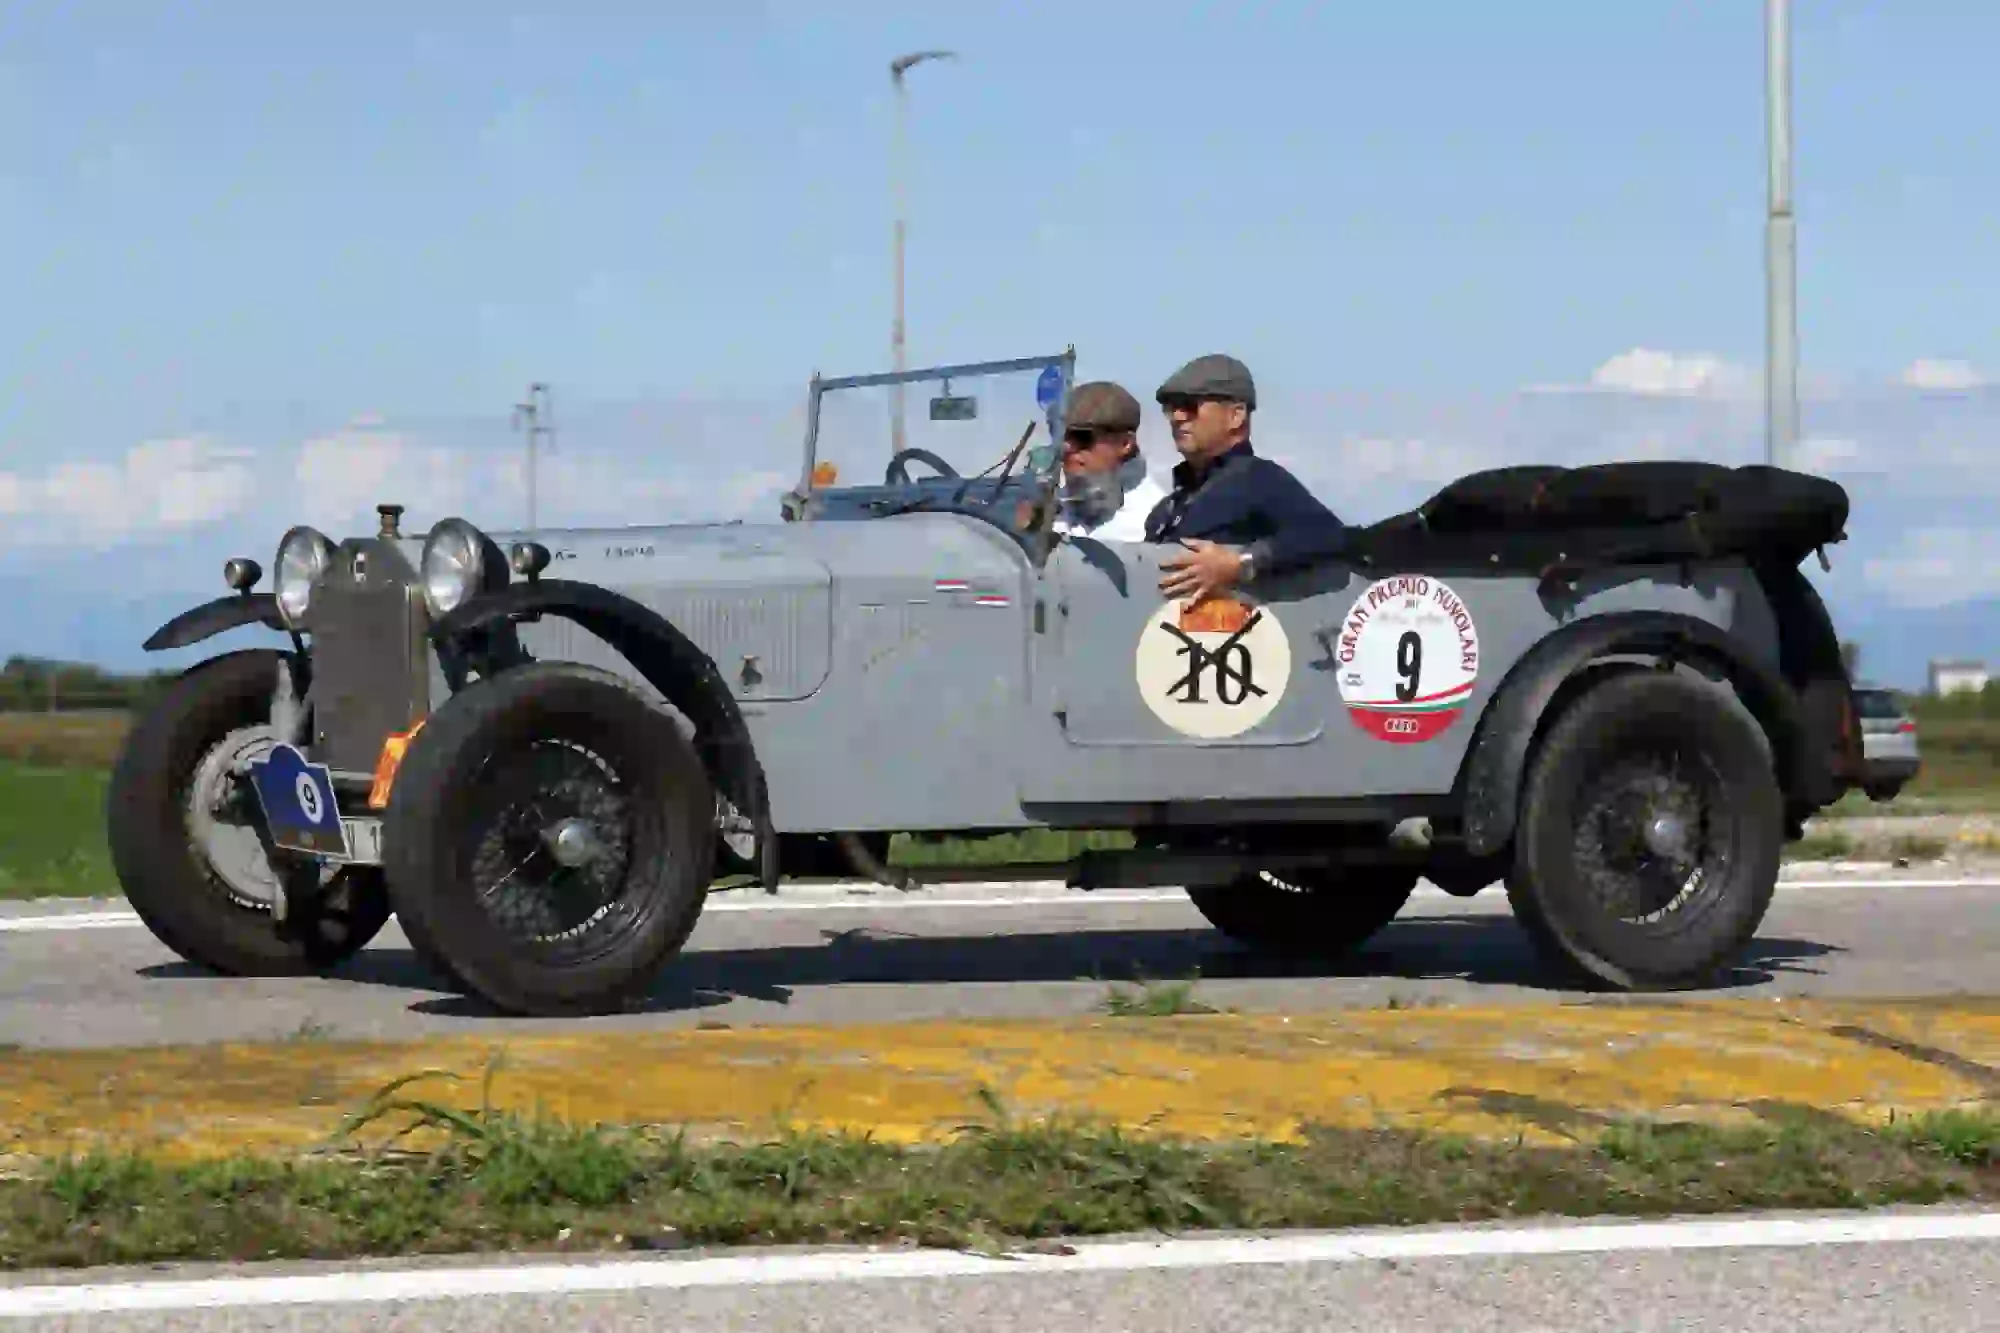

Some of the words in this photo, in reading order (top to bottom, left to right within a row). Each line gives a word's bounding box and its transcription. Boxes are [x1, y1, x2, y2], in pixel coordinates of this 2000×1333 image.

[1339, 605, 1369, 663] GRAN
[1367, 577, 1429, 610] PREMIO
[1433, 589, 1477, 673] NUVOLARI
[1395, 630, 1422, 702] 9
[303, 783, 317, 814] 9
